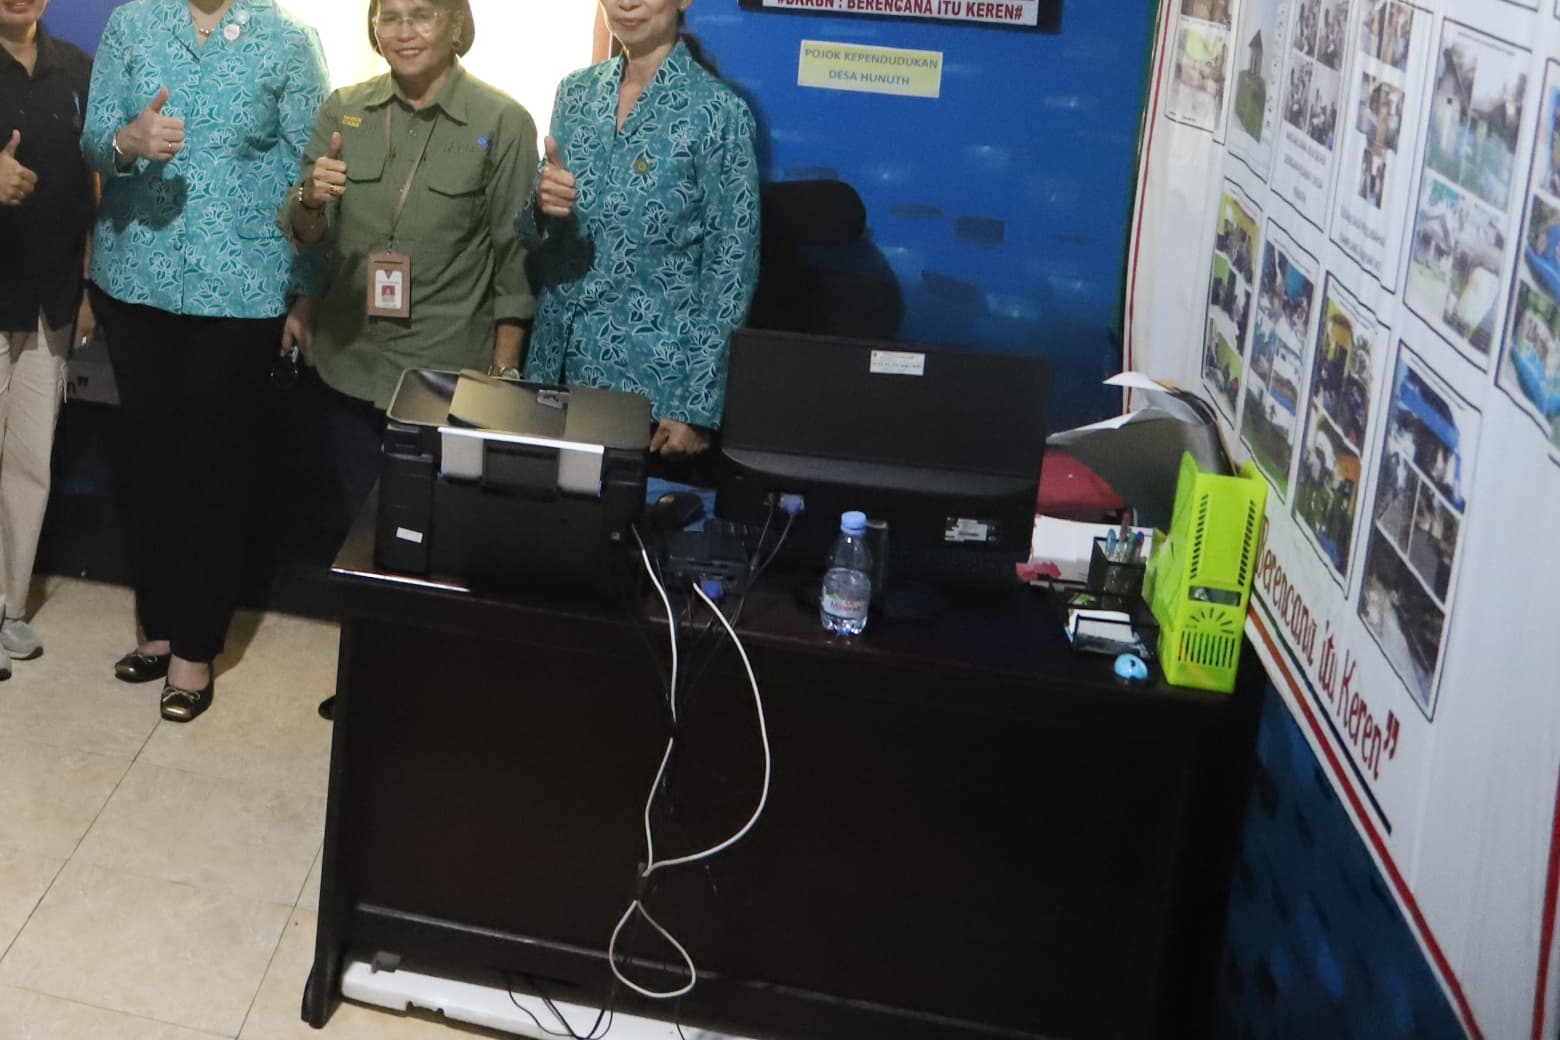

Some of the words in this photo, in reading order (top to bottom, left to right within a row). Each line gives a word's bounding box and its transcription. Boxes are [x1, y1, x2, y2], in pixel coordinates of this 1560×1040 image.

[937, 0, 962, 16] ITU
[965, 1, 1023, 20] KEREN#
[804, 48, 841, 61] POJOK
[844, 52, 938, 69] KEPENDUDUKAN
[828, 69, 858, 81] DESA
[860, 72, 910, 86] HUNUTH
[1319, 619, 1337, 705] itu
